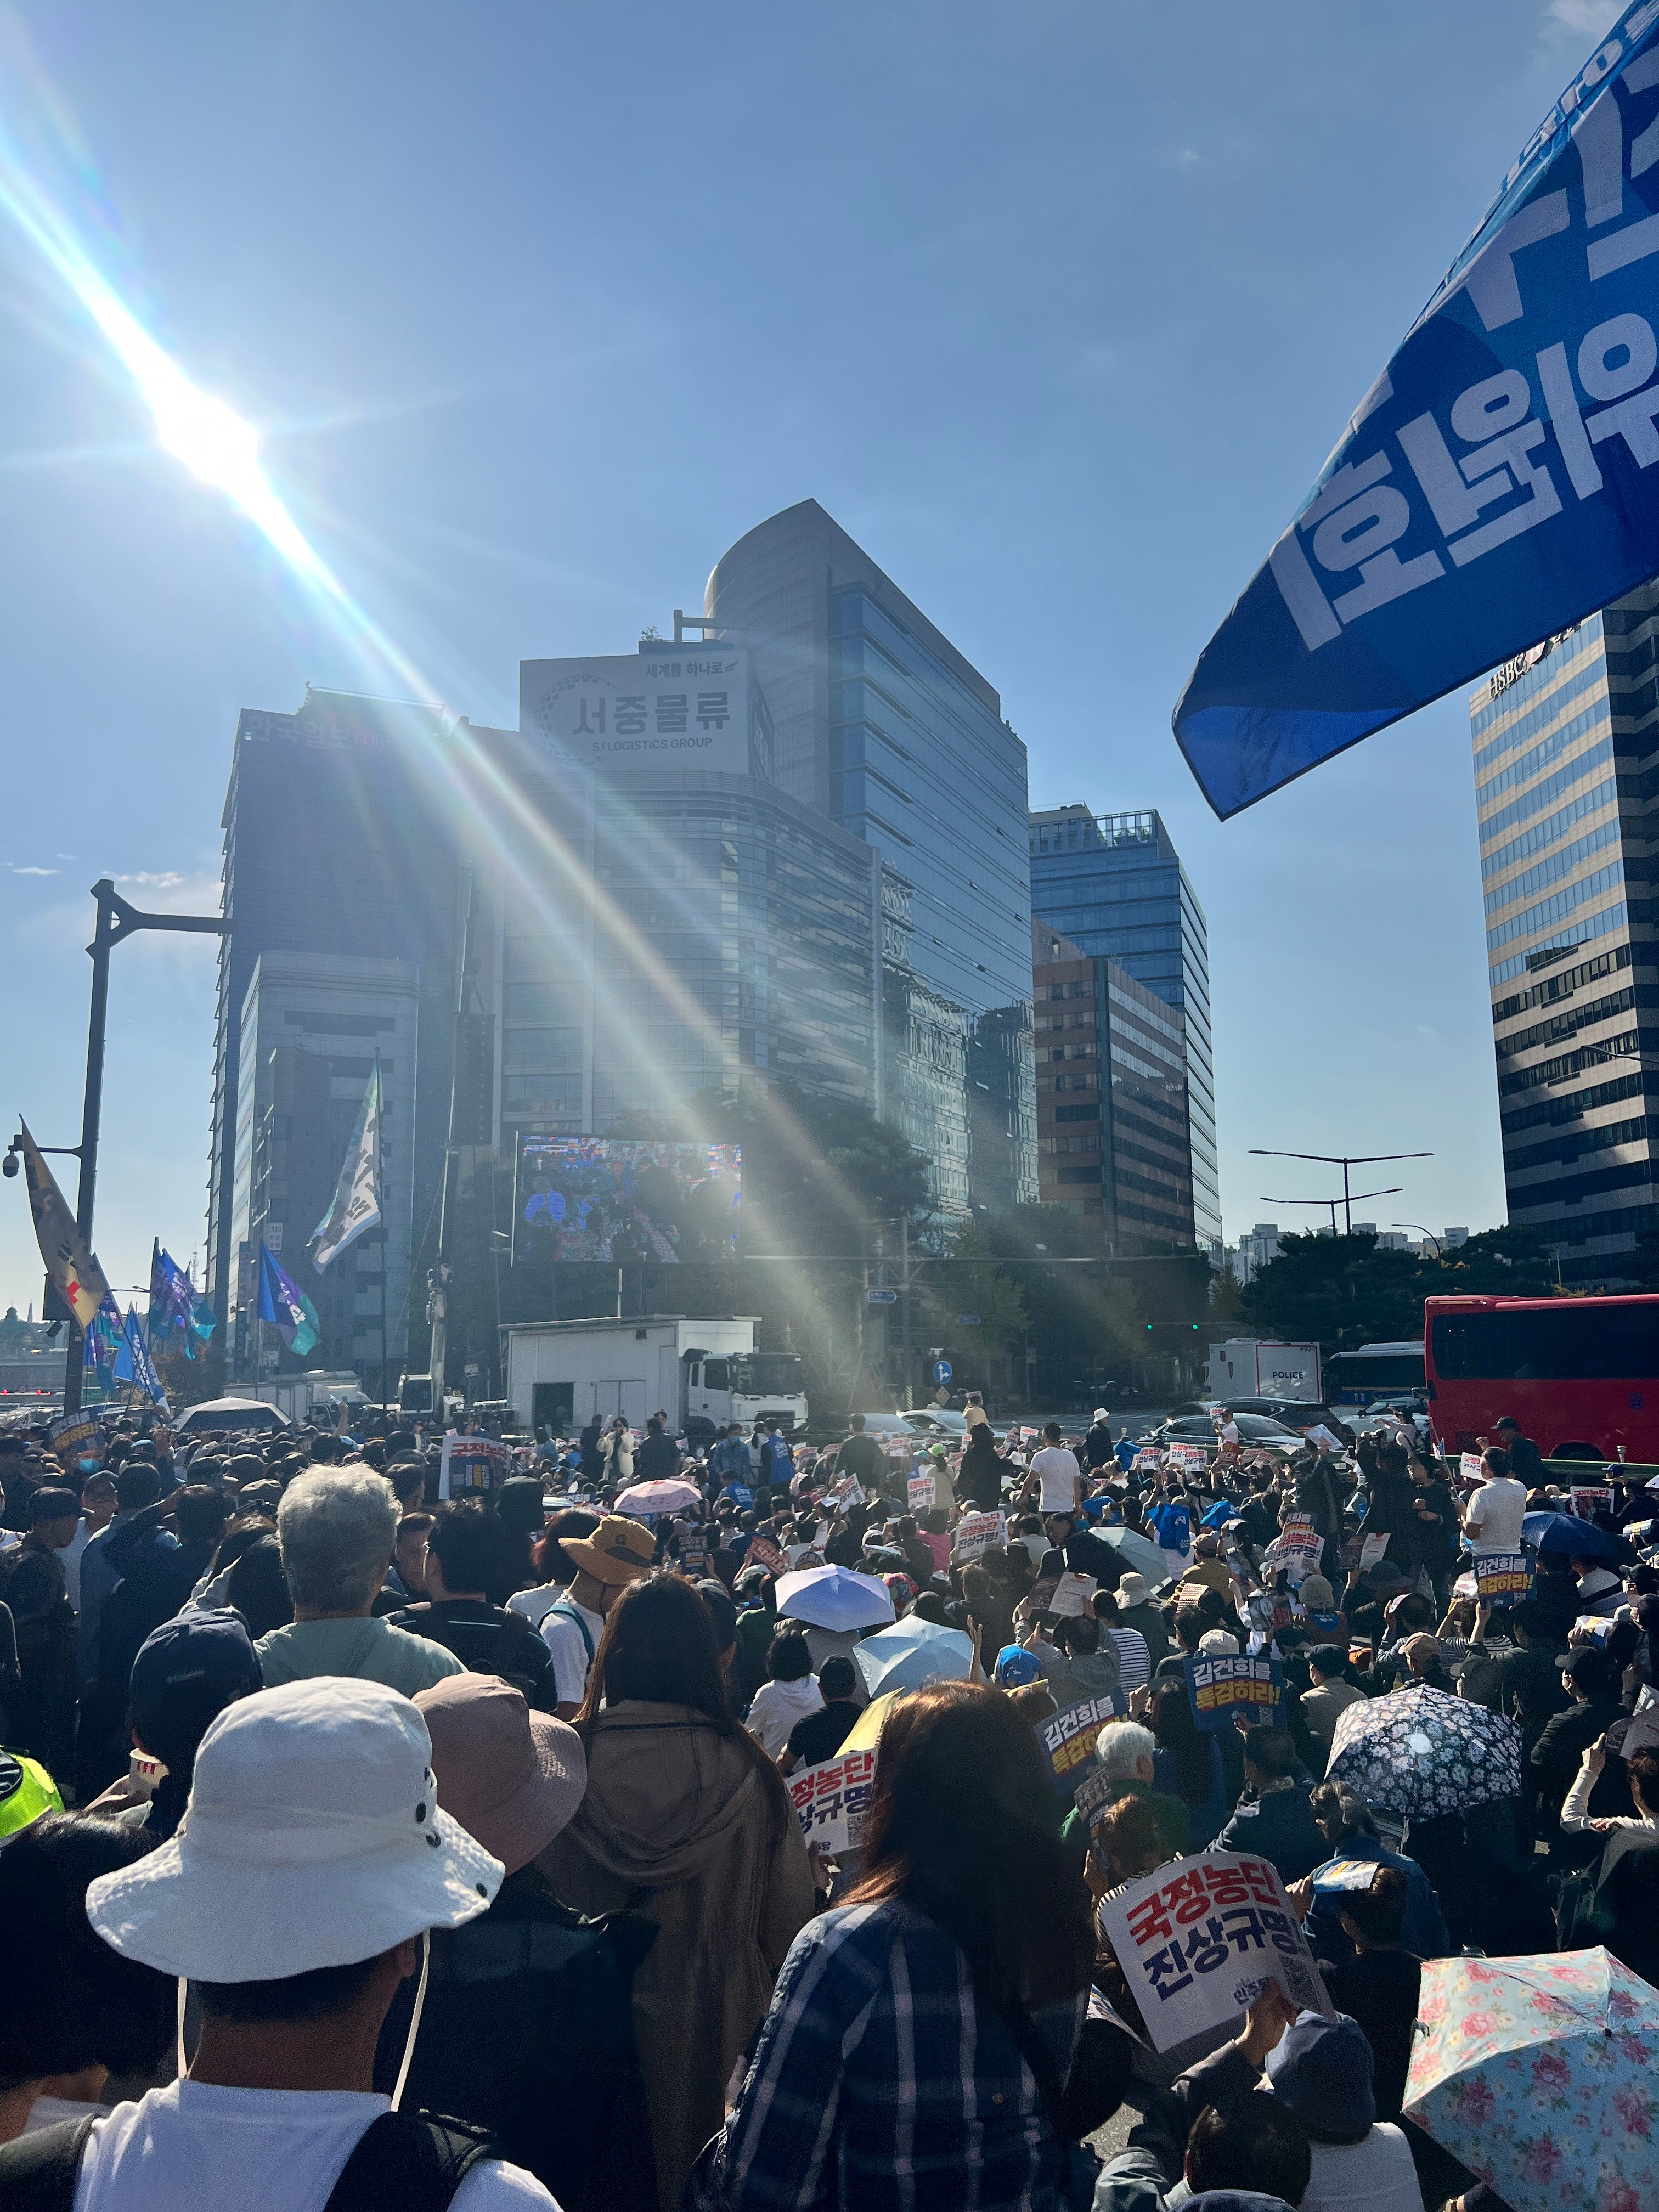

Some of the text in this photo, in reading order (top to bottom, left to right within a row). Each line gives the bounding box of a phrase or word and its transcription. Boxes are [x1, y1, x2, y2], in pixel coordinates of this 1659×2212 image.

[646, 662, 723, 678] 세계를 하나로
[1488, 652, 1526, 699] HSBC
[572, 692, 730, 735] 서중물류
[246, 713, 352, 751] 한국일보
[592, 737, 713, 752] SJ LOGISTICS GROUP
[1272, 1370, 1304, 1379] POLICE
[958, 1531, 999, 1550] 진상규명!
[959, 1522, 997, 1538] 국정농단
[1477, 1556, 1527, 1578] 김건희를
[1479, 1573, 1534, 1595] 특검하라!
[1193, 1657, 1271, 1687] 김건희를
[1195, 1680, 1282, 1709] 특검하라!
[1043, 1695, 1115, 1752] 김건희를
[1126, 1861, 1282, 1946] 국정농단
